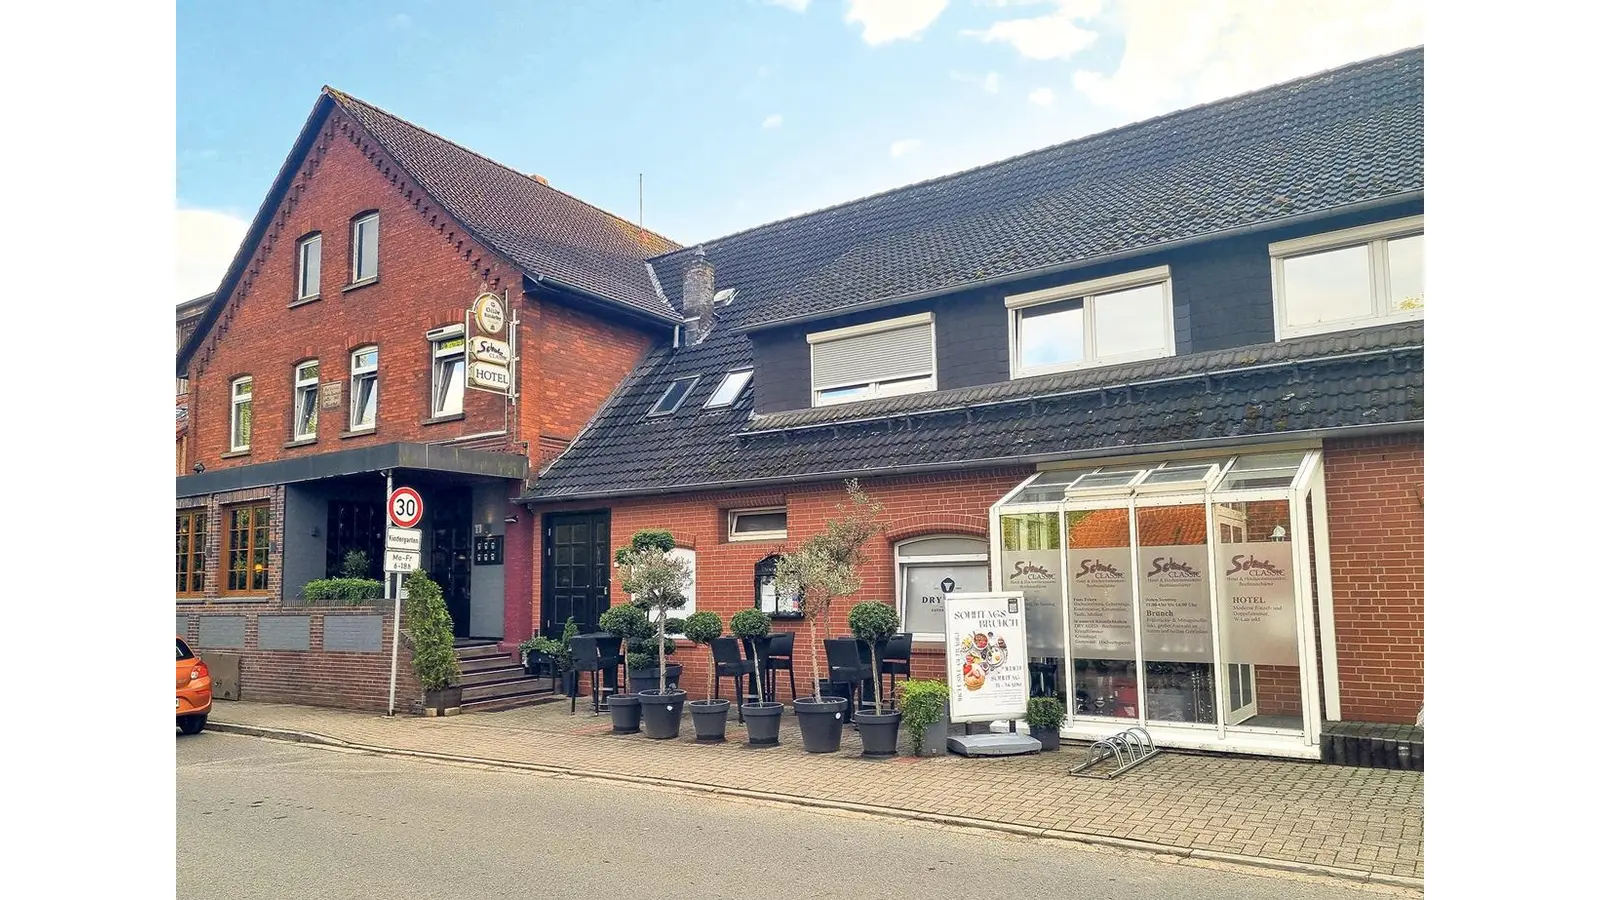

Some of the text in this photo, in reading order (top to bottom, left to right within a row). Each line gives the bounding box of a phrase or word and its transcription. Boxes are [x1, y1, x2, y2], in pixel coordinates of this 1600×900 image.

[476, 369, 508, 384] HOTEL
[396, 499, 415, 516] 30
[389, 535, 418, 544] Kindergarten
[1094, 571, 1125, 579] CLASSIC
[1168, 570, 1202, 578] CLASSIC
[954, 610, 1008, 620] SONNTAGS
[979, 618, 1018, 628] BRUNCH
